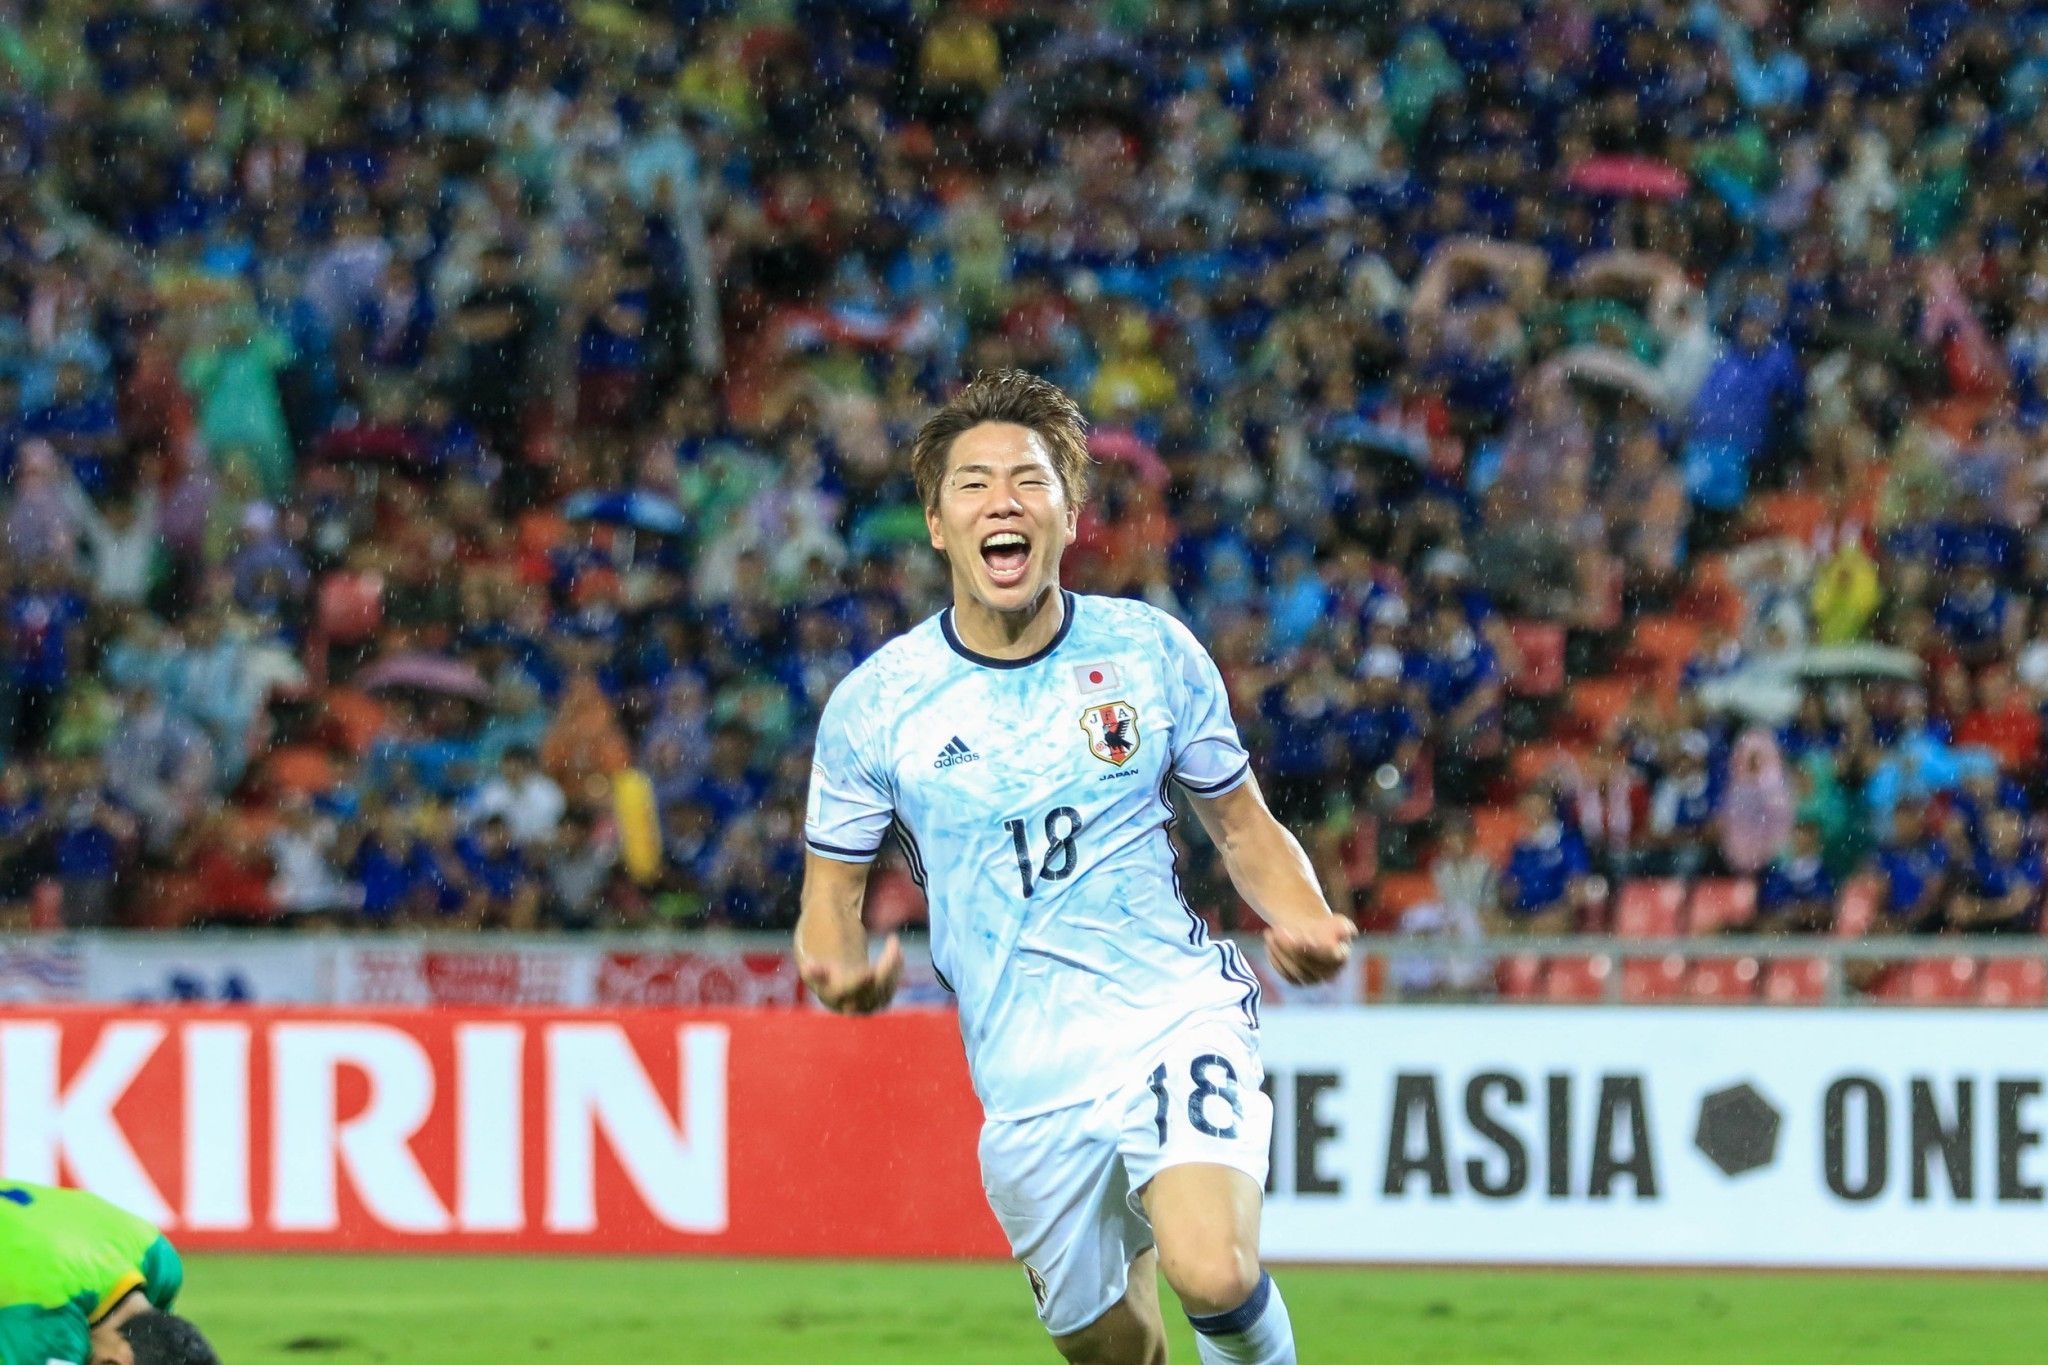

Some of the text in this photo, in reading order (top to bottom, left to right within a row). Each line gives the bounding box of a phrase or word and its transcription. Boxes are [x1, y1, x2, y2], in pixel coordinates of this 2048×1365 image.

[933, 751, 980, 769] adidas
[1089, 707, 1129, 725] JFA
[1098, 768, 1139, 781] JAPAN
[1003, 805, 1083, 899] 18
[0, 1019, 731, 1234] KIRIN
[1146, 1053, 1245, 1148] 18
[1381, 1070, 1660, 1199] ASIA
[1822, 1075, 2044, 1202] ONE
